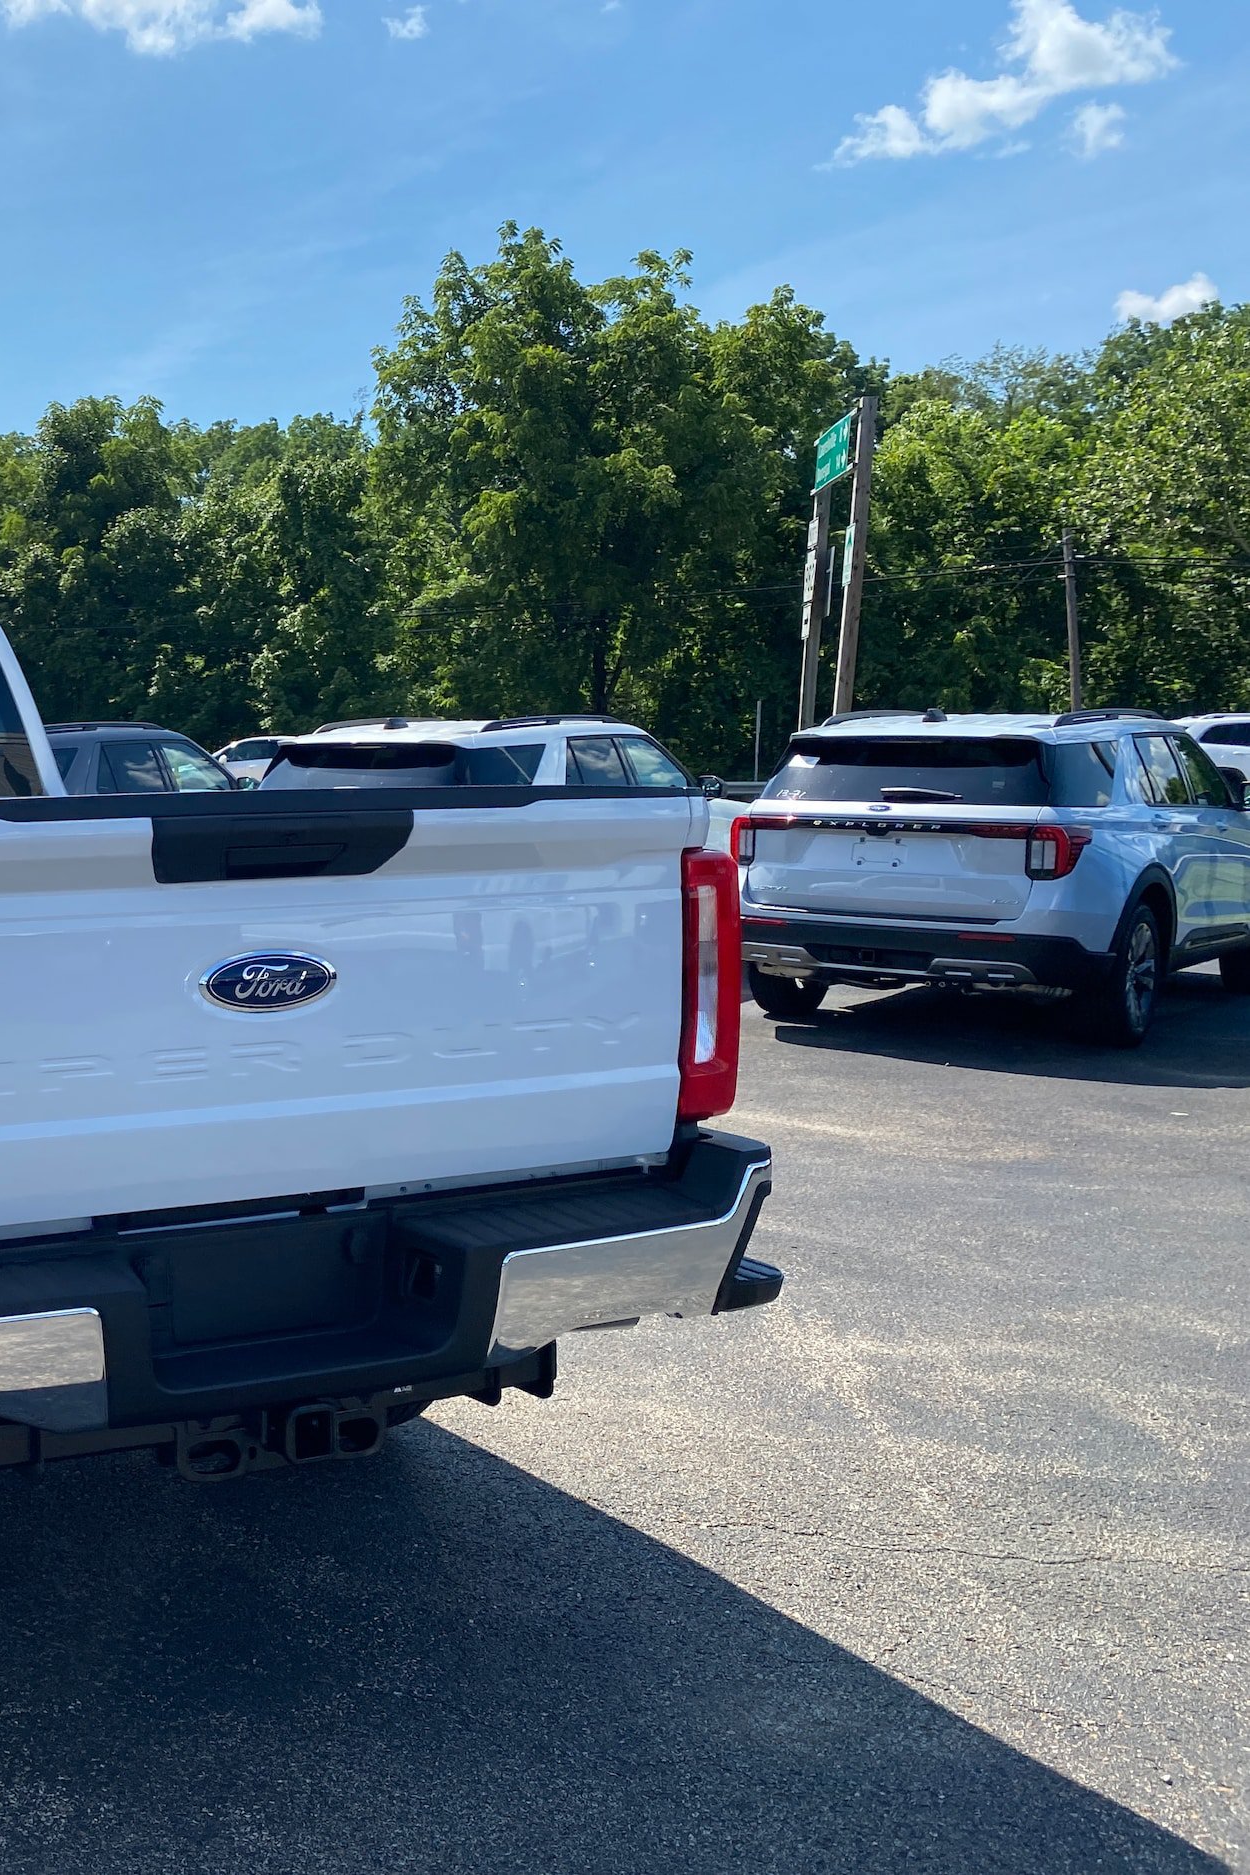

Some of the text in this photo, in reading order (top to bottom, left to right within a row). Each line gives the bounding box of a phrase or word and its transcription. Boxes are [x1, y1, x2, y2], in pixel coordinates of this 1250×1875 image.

[812, 820, 942, 830] EXPLORER
[234, 963, 307, 1000] Ford
[342, 1010, 642, 1068] DUTY
